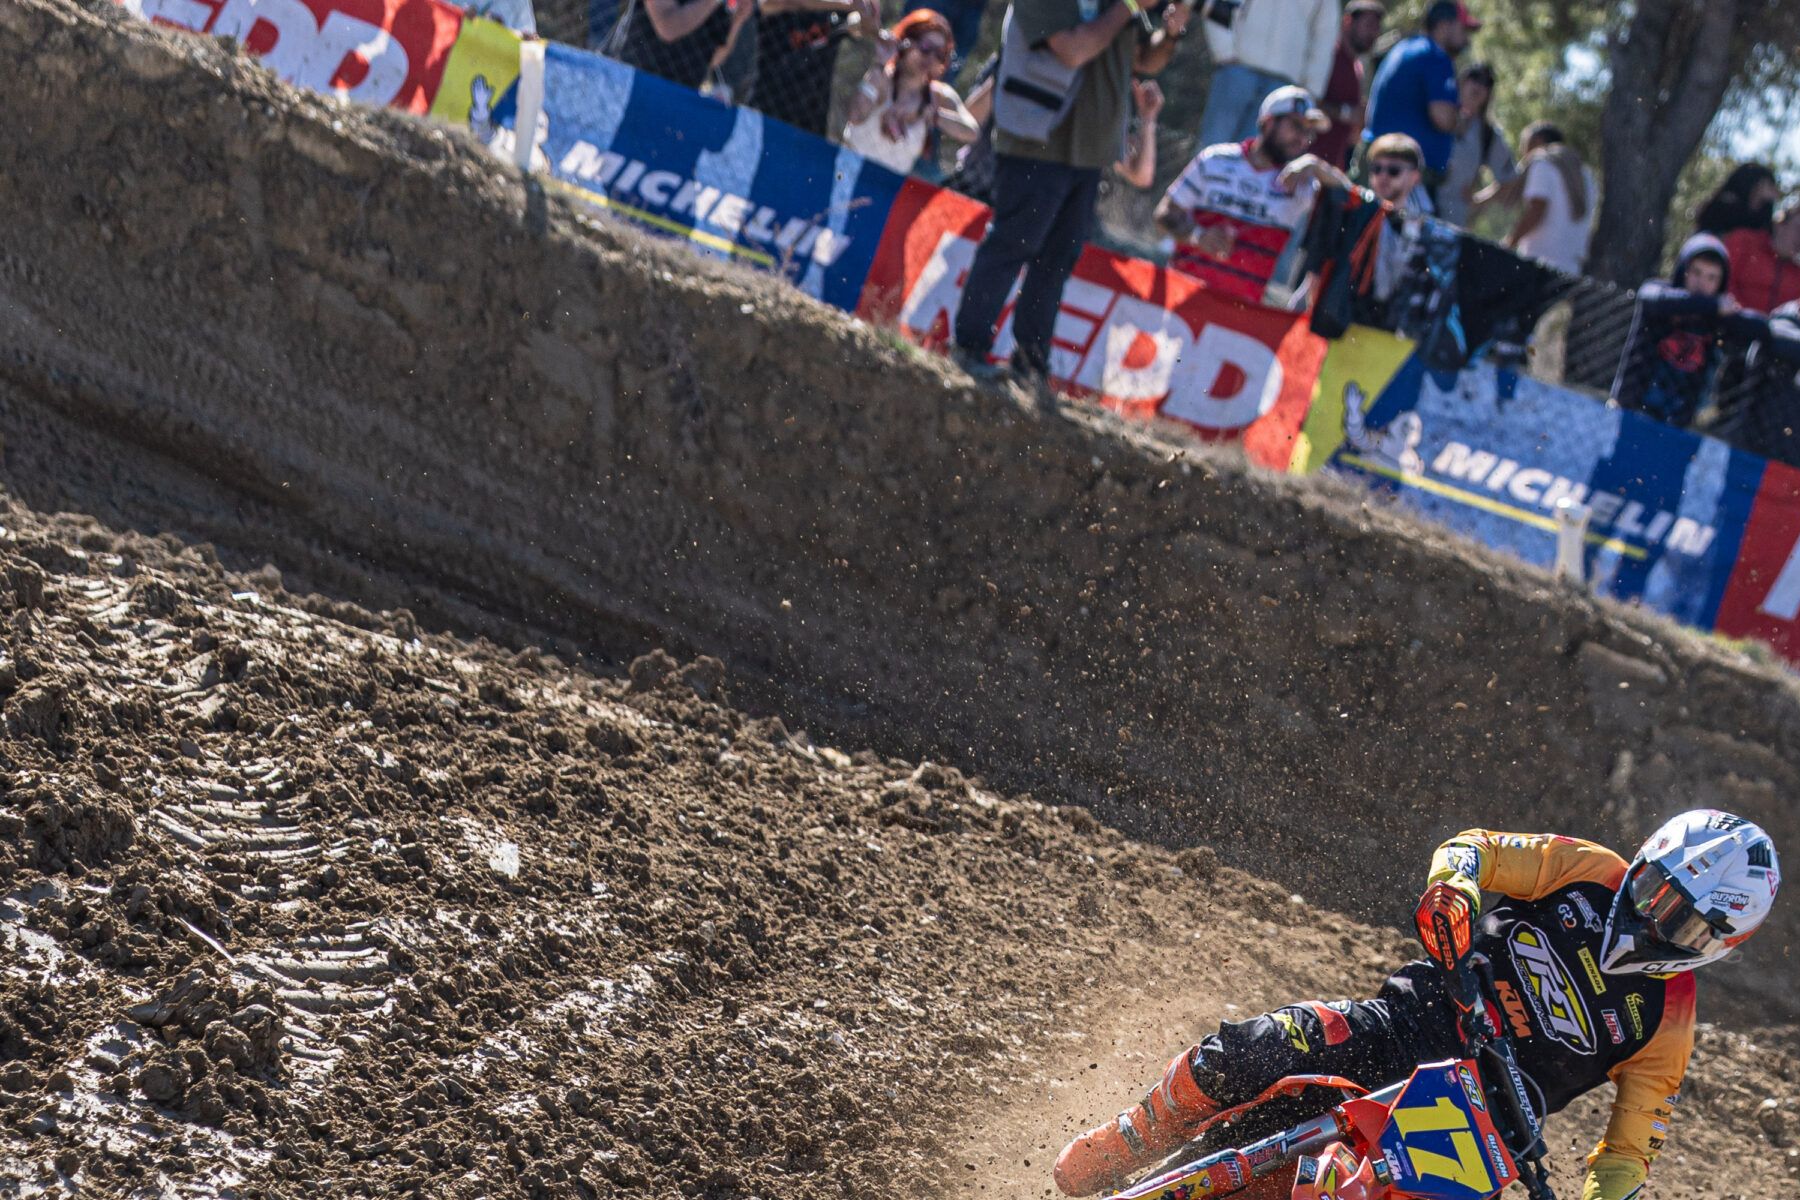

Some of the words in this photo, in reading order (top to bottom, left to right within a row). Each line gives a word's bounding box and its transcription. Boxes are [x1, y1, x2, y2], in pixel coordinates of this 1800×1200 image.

[122, 0, 409, 112] DD
[560, 140, 850, 268] MICHELIN
[1432, 441, 1715, 558] MICHELIN
[1494, 980, 1532, 1039] KTM
[1585, 957, 1604, 993] DUNLOP
[1382, 1149, 1402, 1181] KTM
[1393, 1097, 1494, 1193] 17
